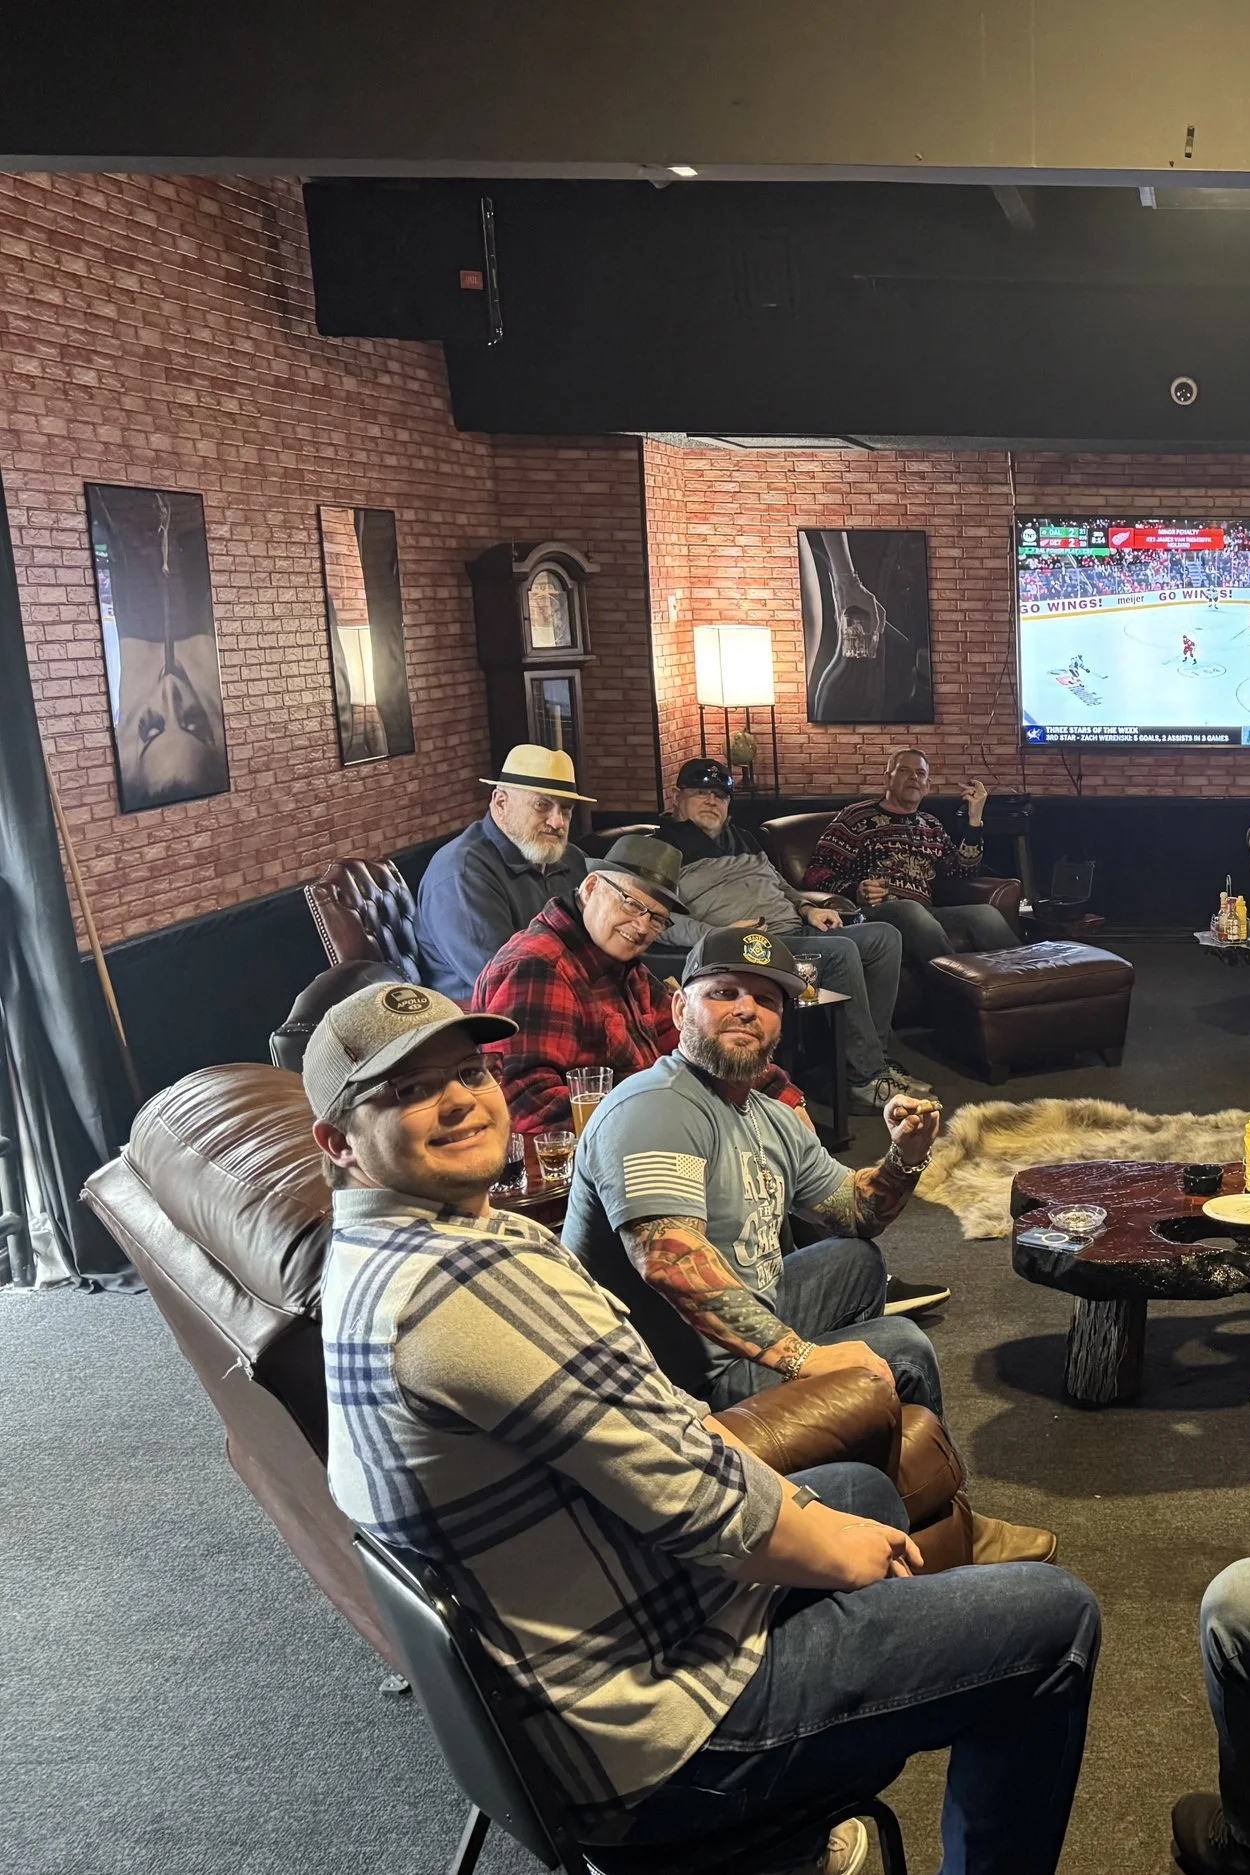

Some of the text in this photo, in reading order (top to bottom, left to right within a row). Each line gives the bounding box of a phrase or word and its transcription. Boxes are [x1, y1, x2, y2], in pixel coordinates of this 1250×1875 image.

[1068, 528, 1075, 537] 2
[1068, 538, 1075, 547] 2
[1117, 594, 1145, 605] meijer
[1159, 589, 1233, 601] GO WINS!
[1020, 598, 1103, 614] GO WINGS!
[1139, 734, 1161, 742] GOALS,
[397, 998, 427, 1009] APOLLO
